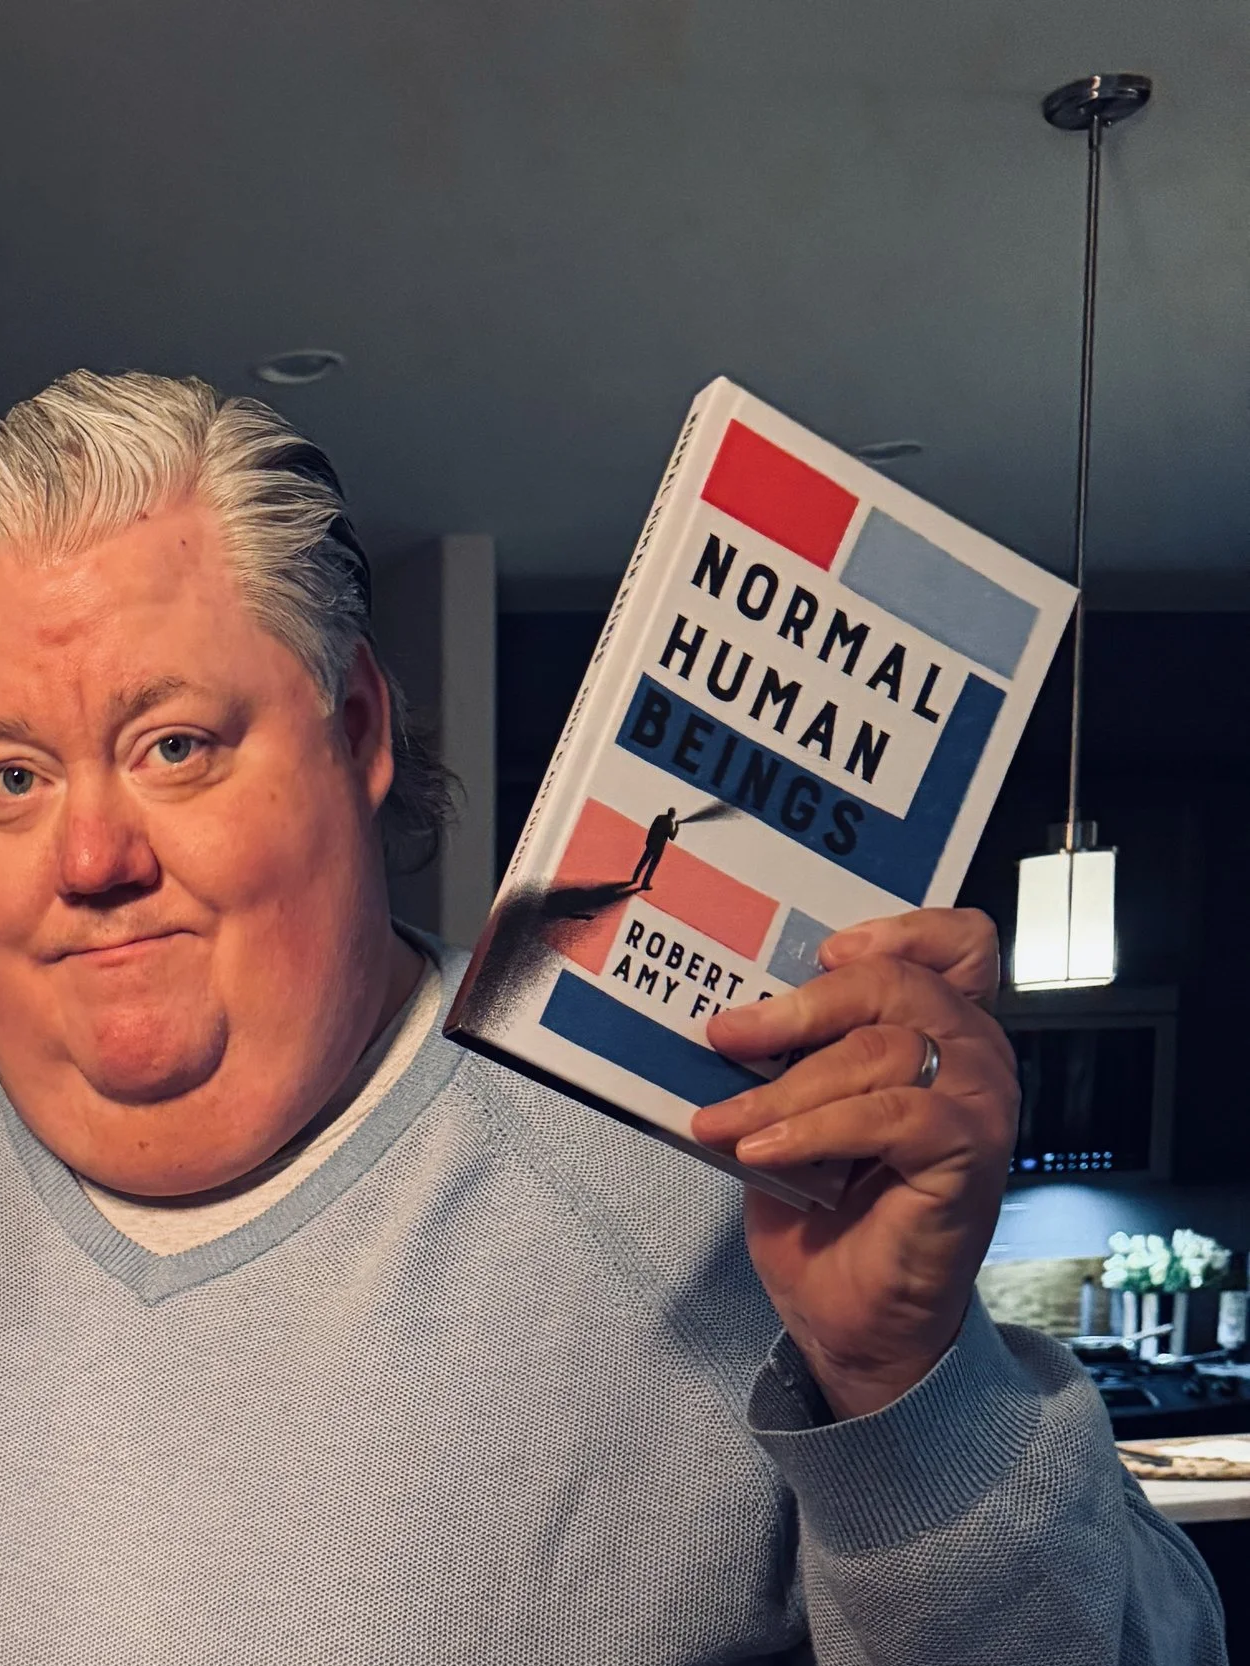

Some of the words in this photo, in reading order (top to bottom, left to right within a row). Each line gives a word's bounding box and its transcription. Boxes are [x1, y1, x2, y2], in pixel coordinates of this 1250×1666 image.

[661, 412, 699, 499] NORMAL
[628, 505, 663, 580] HUMAN
[594, 587, 628, 664] BEINGS
[690, 533, 947, 724] NORMAL
[658, 613, 890, 783] HUMAN
[628, 683, 866, 855] BEINGS
[612, 954, 680, 1004] AMY
[625, 919, 744, 1000] ROBERT
